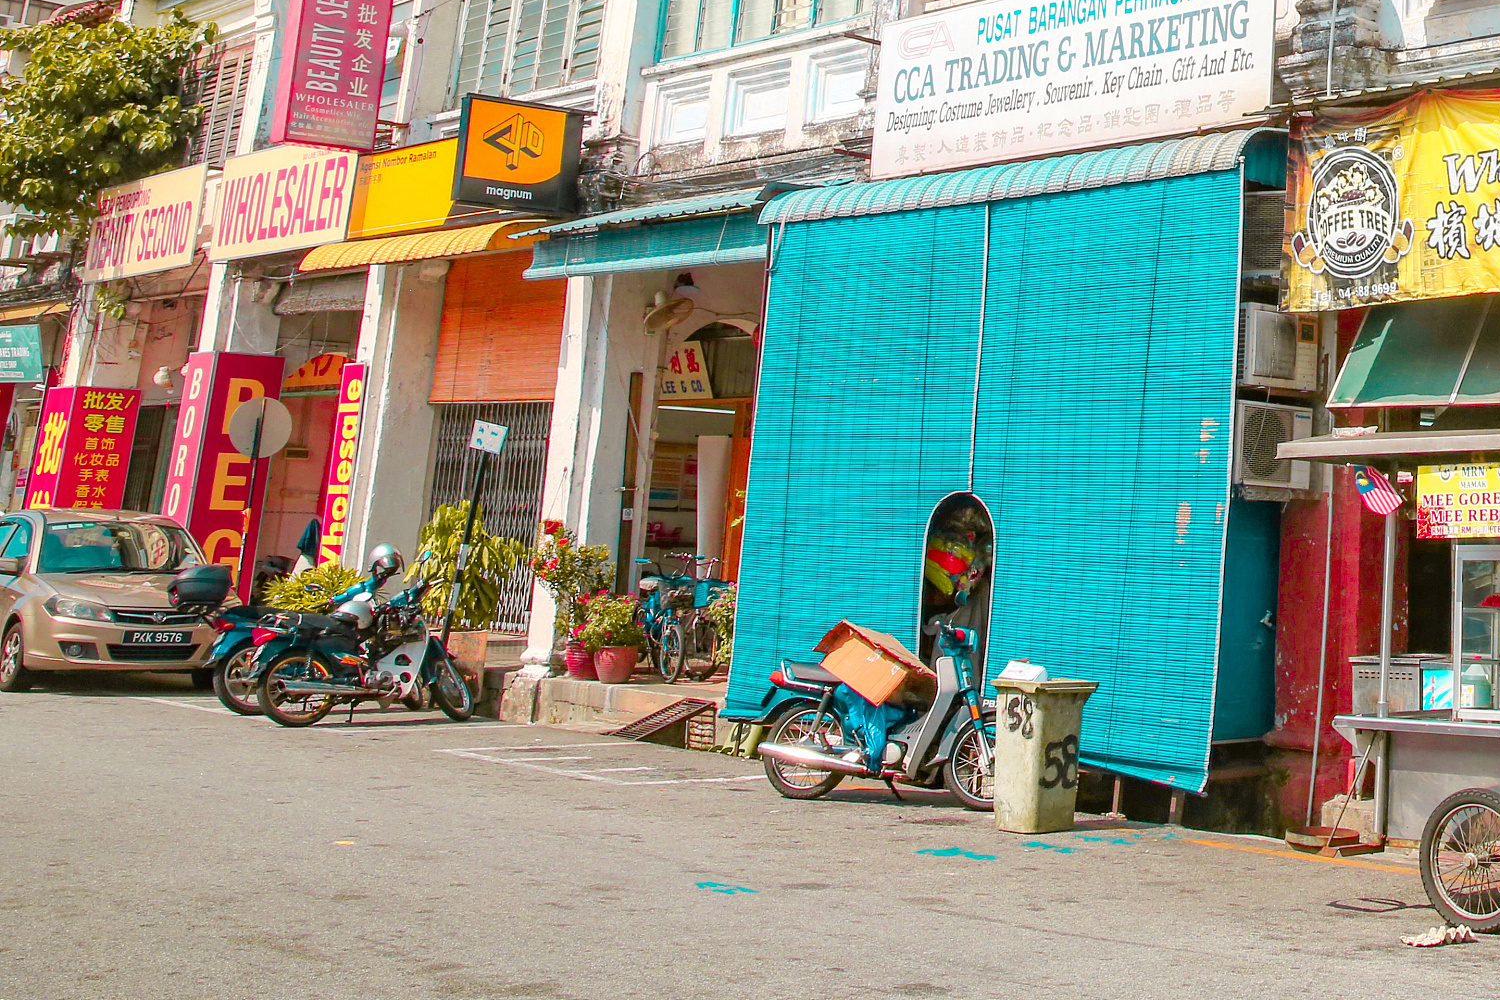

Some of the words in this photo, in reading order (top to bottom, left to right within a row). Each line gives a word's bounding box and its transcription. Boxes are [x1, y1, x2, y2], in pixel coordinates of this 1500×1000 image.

[976, 9, 1022, 45] PUSAT
[305, 22, 346, 93] BEAUTY
[893, 64, 937, 104] CCA
[944, 40, 1050, 94] TRADING
[1057, 36, 1077, 73] &
[1082, 0, 1250, 68] MARKETING
[886, 109, 938, 135] Designing:
[938, 101, 983, 124] Costume
[984, 89, 1036, 116] Jewellery
[1043, 75, 1094, 105] Souvenir
[1101, 71, 1125, 98] Key
[1127, 63, 1163, 90] Chain
[1171, 56, 1197, 83] Gift
[1198, 51, 1227, 78] And
[1230, 48, 1255, 73] Etc.
[295, 92, 375, 112] WHOLESALER
[293, 111, 310, 120] Hair
[360, 159, 382, 172] Agensi
[382, 155, 408, 169] Nombor
[408, 150, 437, 164] Ramalan
[217, 155, 349, 247] WHOLESALER
[486, 185, 533, 201] magnum
[1358, 209, 1389, 236] TREE
[89, 212, 140, 270] BEAUTY
[136, 200, 193, 262] SECOND
[1324, 244, 1354, 264] PREMIUM
[1354, 235, 1383, 263] QUALITY
[1371, 281, 1397, 296] 9699
[84, 413, 126, 434] 零售
[85, 437, 116, 450] 首饰
[74, 453, 120, 467] 化妆品
[79, 468, 110, 482] 手表
[1461, 465, 1486, 478] MRN
[76, 484, 107, 498] 香水
[1460, 480, 1487, 489] MAMAK
[1422, 493, 1454, 507] MEE
[1430, 509, 1463, 523] MEE
[155, 632, 183, 643] 9576
[1038, 733, 1079, 790] 58
